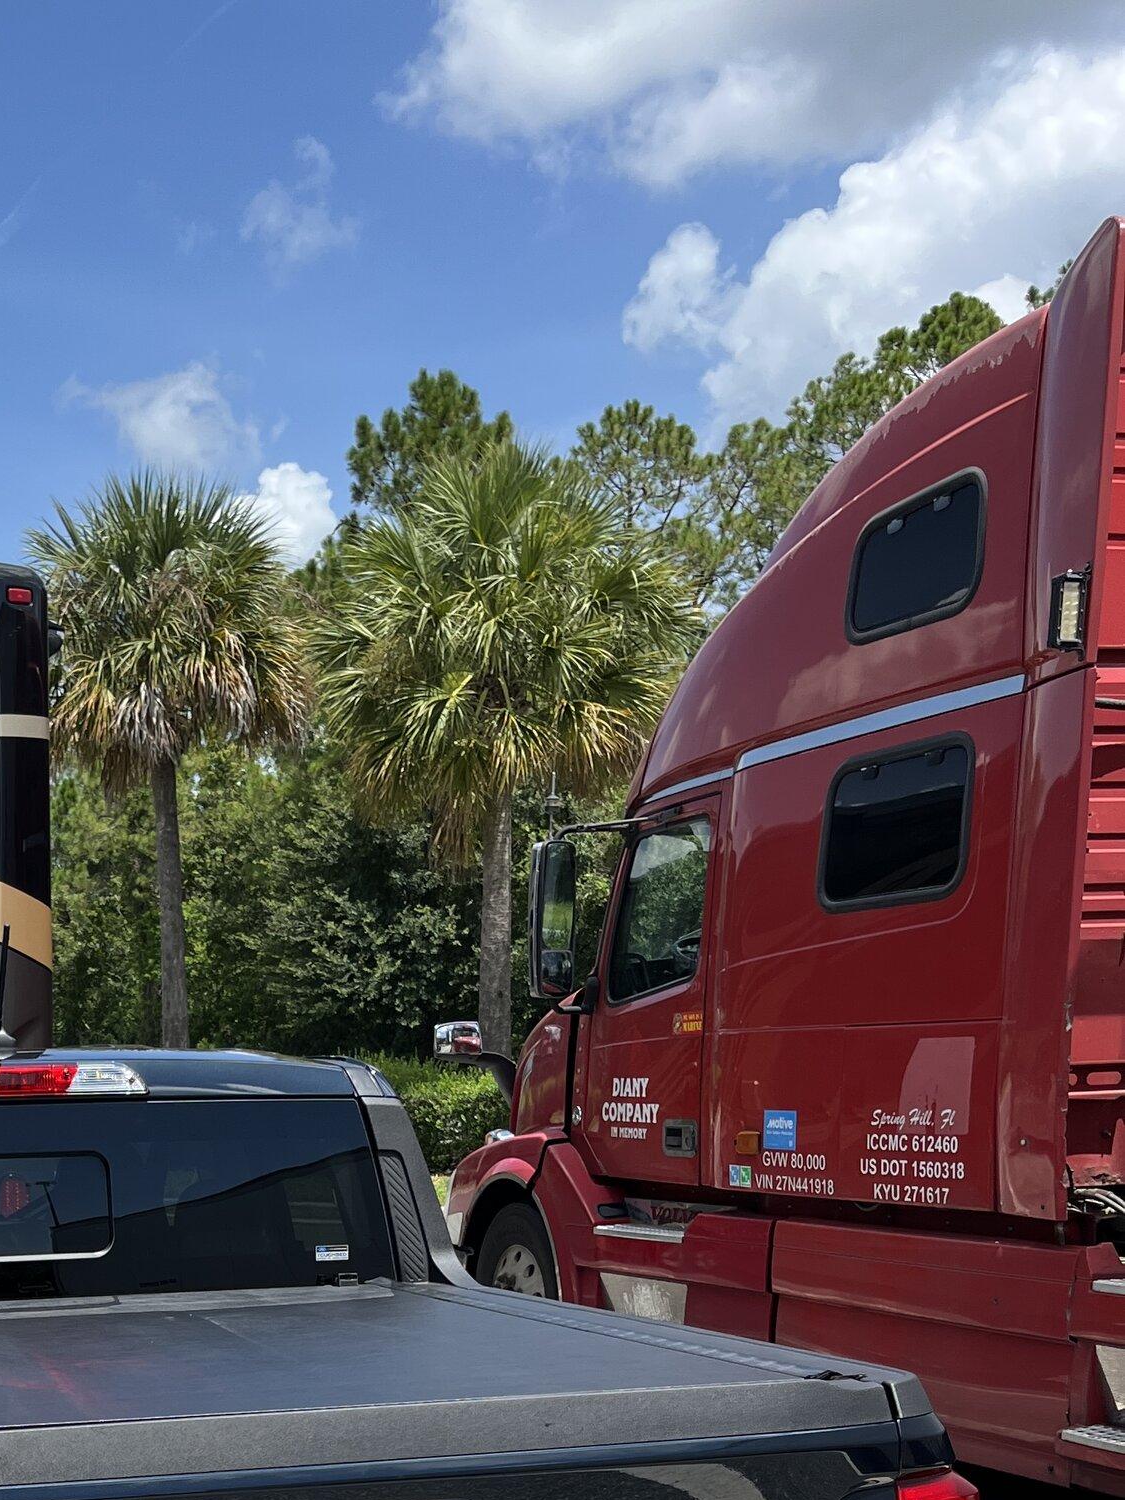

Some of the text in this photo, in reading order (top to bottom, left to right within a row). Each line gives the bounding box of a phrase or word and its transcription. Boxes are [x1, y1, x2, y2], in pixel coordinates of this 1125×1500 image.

[612, 1077, 649, 1098] DIANY
[602, 1102, 660, 1124] COMPANY
[766, 1116, 794, 1130] Motive
[871, 1109, 906, 1130] Spring
[940, 1108, 956, 1129] Fl
[610, 1126, 648, 1140] IN MEMORY
[866, 1133, 959, 1154] ICCMC 612460
[762, 1151, 826, 1171] GVW 80,000
[860, 1158, 965, 1179] US DOT 1560318
[755, 1173, 835, 1195] VIN 27N441918
[873, 1183, 950, 1204] KYU 271617
[650, 1205, 697, 1225] VOLV
